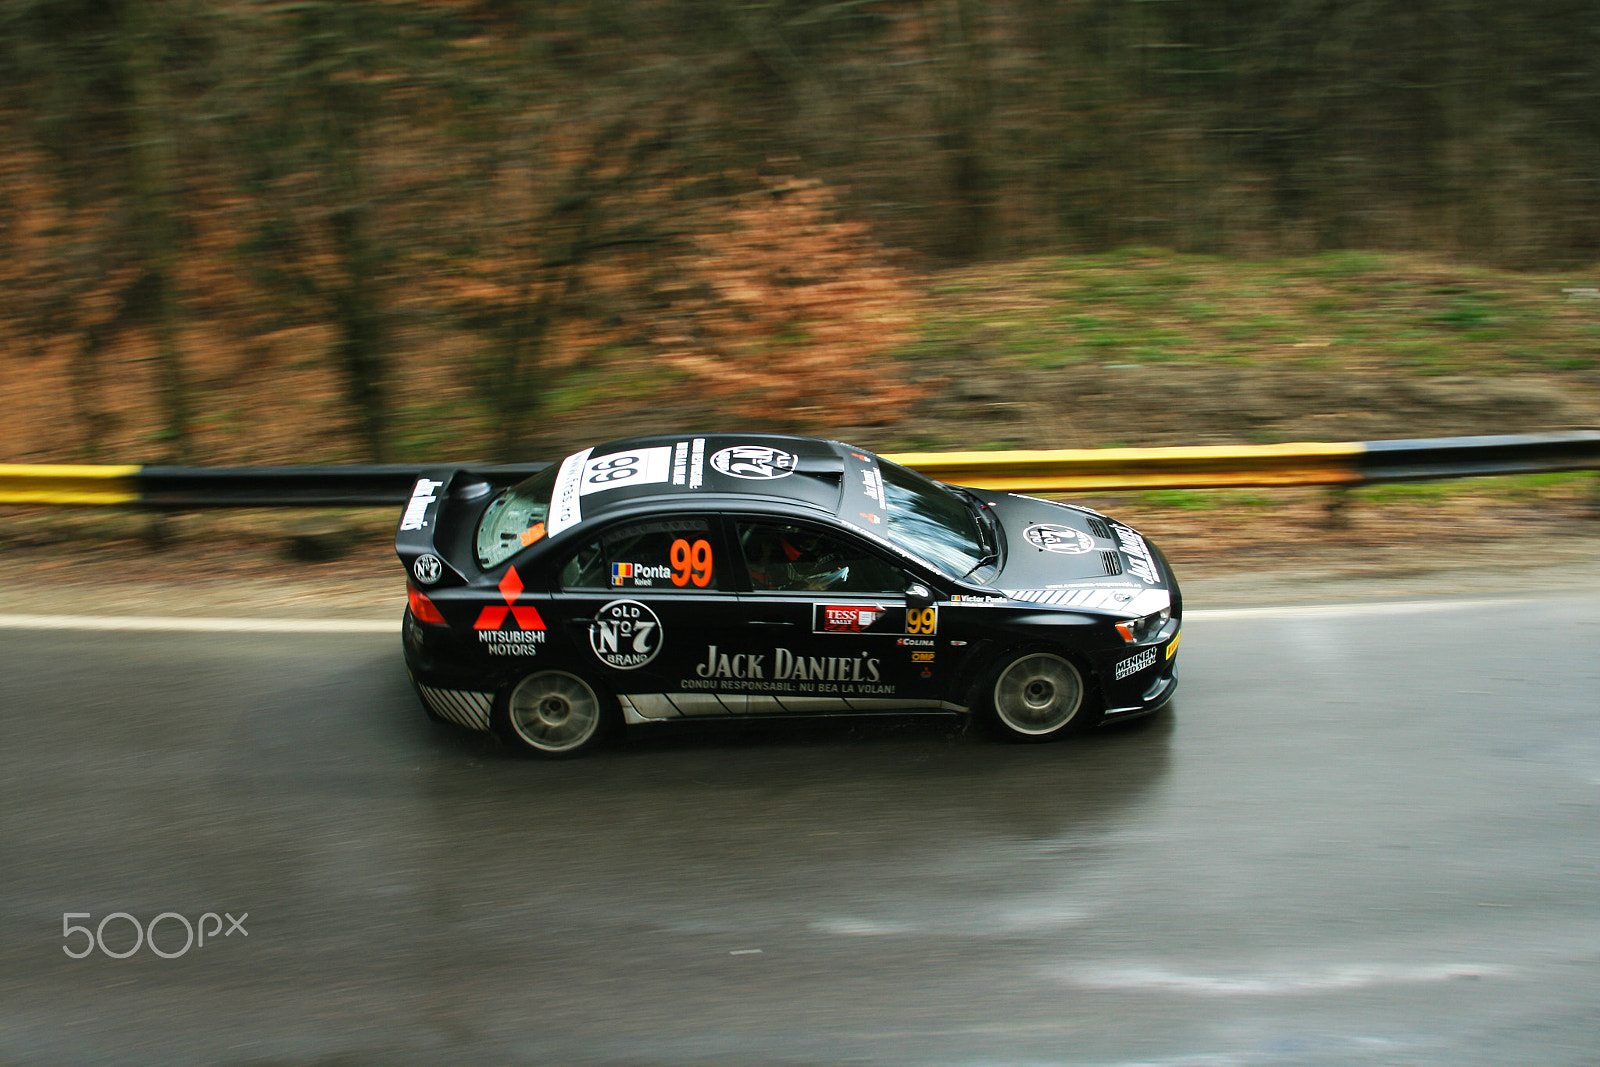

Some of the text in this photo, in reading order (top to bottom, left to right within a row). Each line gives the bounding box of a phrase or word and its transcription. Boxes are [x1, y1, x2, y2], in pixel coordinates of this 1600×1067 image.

[589, 456, 640, 483] 99
[670, 538, 713, 588] 99
[634, 563, 671, 579] Ponta
[961, 594, 984, 602] Victor
[612, 605, 640, 618] OLD
[826, 609, 857, 620] TESS
[907, 608, 935, 634] 99
[478, 630, 545, 643] MITSUBISHI
[488, 643, 536, 656] MOTORS
[911, 653, 935, 661] OMP
[607, 654, 648, 666] BRAND
[696, 645, 880, 683] JACK DANIEL'S
[1116, 646, 1157, 673] MENNEN
[1116, 657, 1157, 680] SPEED STICK
[681, 679, 895, 694] CONDU RESPONSABIL: NU BEA LA VOLAN!
